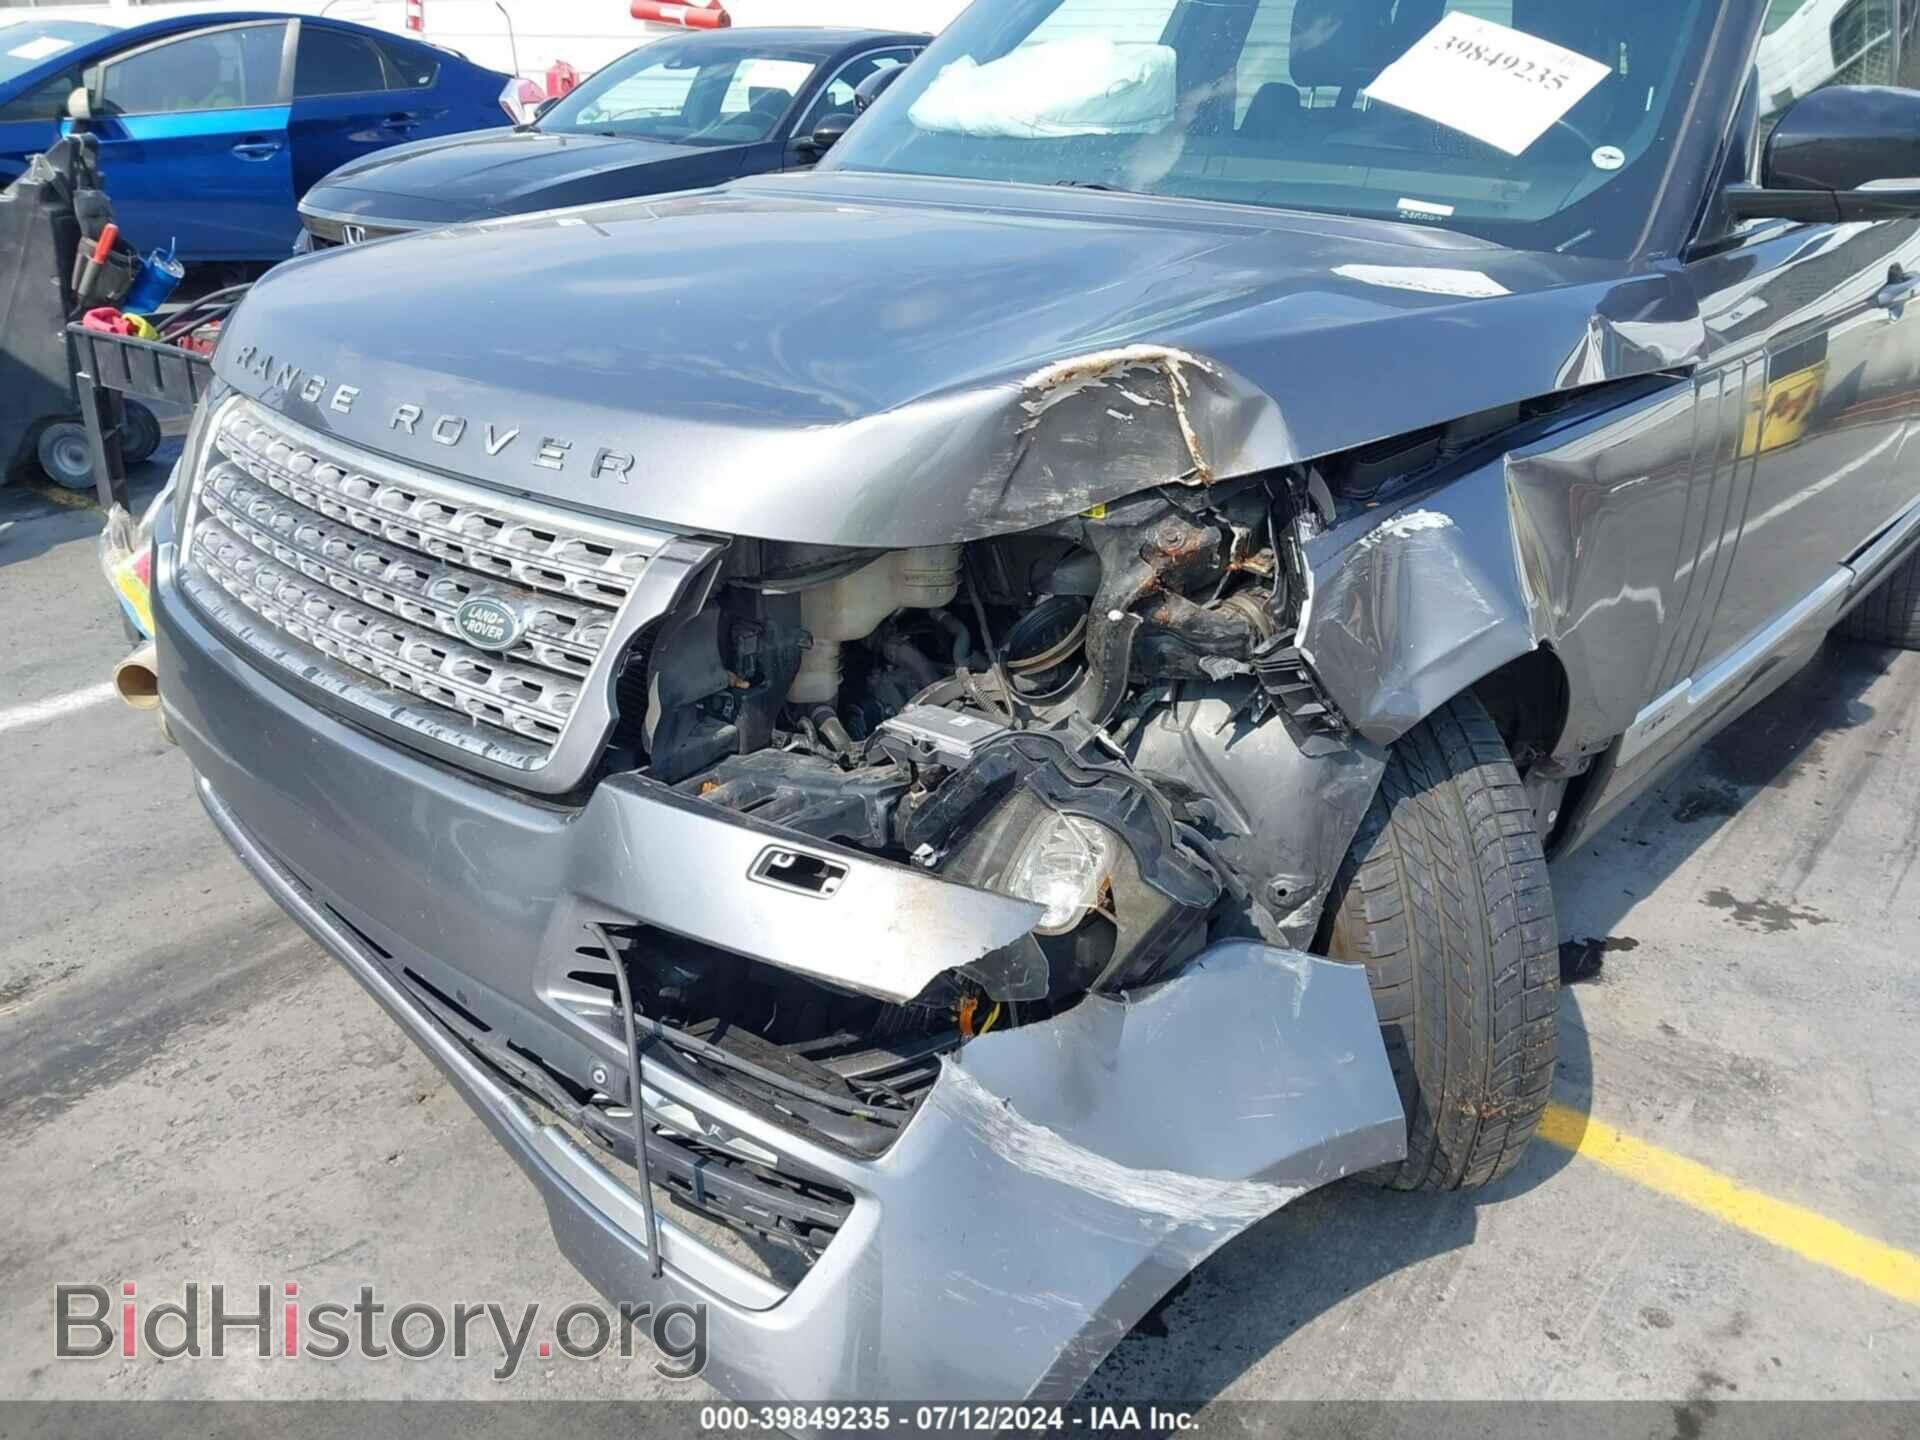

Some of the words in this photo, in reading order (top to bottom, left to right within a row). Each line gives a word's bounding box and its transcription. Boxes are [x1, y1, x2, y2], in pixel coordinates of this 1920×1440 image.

[1434, 36, 1569, 90] 39849235
[236, 346, 360, 414] RANGE
[389, 403, 635, 484] ROVER
[466, 619, 504, 640] ROVER
[468, 606, 498, 624] LAND
